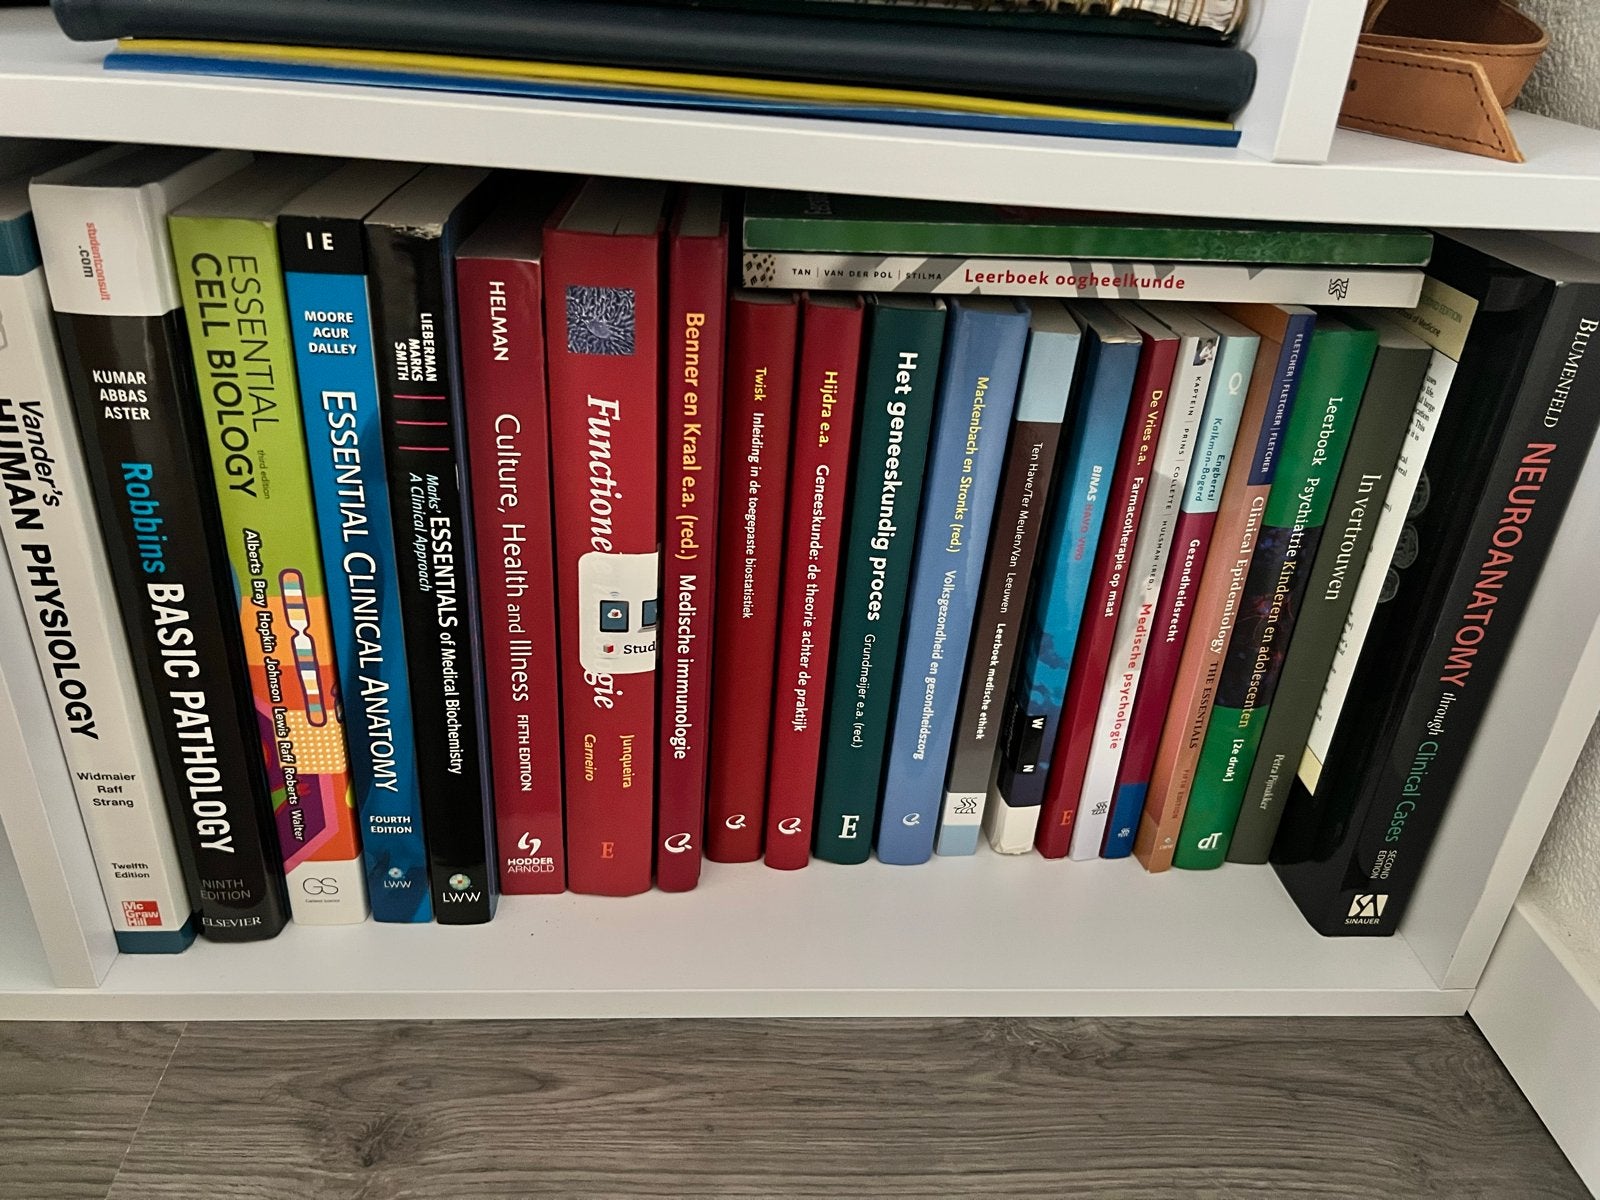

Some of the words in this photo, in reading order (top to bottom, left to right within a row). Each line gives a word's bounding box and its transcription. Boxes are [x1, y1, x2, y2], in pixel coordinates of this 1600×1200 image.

[78, 245, 94, 278] .com
[86, 222, 111, 300] studentconsult
[792, 268, 811, 276] TAN
[824, 269, 844, 278] VAN
[849, 270, 868, 279] DER
[873, 271, 893, 279] POL
[906, 272, 943, 280] STILMA
[965, 269, 1049, 285] Leerboek
[1056, 274, 1185, 289] oogheelkunde
[191, 253, 231, 337] CELL
[304, 311, 354, 323] MOORE
[313, 327, 349, 339] AGUR
[489, 281, 509, 361] HELMAN
[228, 255, 279, 432] ESSENTIAL
[308, 342, 357, 355] DALLEY
[395, 342, 409, 381] SMITH
[408, 338, 423, 382] MARKS
[420, 312, 437, 382] LIEBERMAN
[684, 312, 705, 387] Benner
[1285, 333, 1304, 377] FLETCHER
[93, 370, 147, 385] KUMAR
[754, 367, 767, 401] Twisk
[895, 351, 919, 394] Het
[1543, 317, 1600, 428] BLUMENFELD
[100, 388, 148, 403] ABBAS
[104, 406, 151, 421] ASTER
[683, 392, 698, 416] en
[819, 371, 838, 418] Hijdra
[965, 376, 990, 455] Mackenbach
[1150, 390, 1163, 408] De
[1187, 376, 1202, 416] KAPTEIN
[1273, 384, 1290, 426] FLETCHER
[208, 351, 257, 498] BIOLOGY
[748, 412, 765, 463] Inleiding
[818, 422, 831, 448] e.a.
[1142, 410, 1159, 441] Vries
[1178, 428, 1190, 455] PRINS
[1311, 397, 1343, 466] Leerboek
[19, 401, 63, 507] Vander's
[322, 390, 368, 542] ESSENTIAL
[494, 413, 522, 513] Culture,
[683, 423, 702, 471] Kraal
[963, 458, 973, 473] en
[1030, 442, 1044, 460] Ten
[1137, 444, 1149, 466] e.a.
[1195, 417, 1223, 502] Kalkman-Bogerd
[1261, 433, 1278, 473] FLETCHER
[681, 476, 696, 508] e.a.
[749, 480, 761, 494] de
[750, 466, 760, 477] in
[870, 401, 907, 551] geneeskundig
[1022, 463, 1039, 508] Have/Ter
[1087, 465, 1102, 502] BINAS
[1165, 466, 1181, 510] COLLETTE
[1358, 473, 1382, 493] In
[121, 462, 166, 574] Robbins
[410, 486, 425, 533] Clinical
[808, 464, 830, 561] Geneeskunde:
[955, 476, 973, 521] Stronks
[1286, 477, 1320, 557] Psychiatrie
[675, 514, 699, 560] (red.)
[744, 496, 759, 554] toegepaste
[946, 523, 965, 554] (red.)
[1009, 510, 1029, 567] Meulen/Van
[1114, 477, 1144, 571] Farmacotherapie
[1153, 520, 1168, 561] HULSMAN
[1238, 496, 1264, 554] Clinical
[245, 529, 261, 573] Alberts
[414, 535, 432, 592] Approach
[502, 524, 529, 597] Health
[1325, 496, 1370, 601] vertrouwen
[1439, 442, 1557, 688] NEUROANATOMY
[253, 581, 266, 606] Bray
[430, 517, 458, 628] ESSENTIALS
[742, 557, 756, 618] biostatistiek
[807, 564, 822, 580] de
[867, 557, 887, 621] proces
[1001, 572, 1016, 613] Leeuwen
[1109, 573, 1121, 587] op
[1166, 539, 1200, 643] Gezondheidsrecht
[1268, 559, 1297, 625] Kinderen
[343, 552, 384, 668] CLINICAL
[507, 603, 526, 633] and
[677, 574, 697, 654] Medische
[803, 582, 820, 627] theorie
[930, 570, 957, 660] Volksgezondheid
[1105, 591, 1117, 617] maat
[1210, 558, 1248, 654] Epidemiology
[21, 544, 99, 740] PHYSIOLOGY
[147, 583, 200, 679] BASIC
[259, 612, 273, 652] Hopkin
[799, 630, 815, 668] achter
[989, 623, 1006, 666] Leerboek
[1128, 604, 1153, 669] Medische
[1263, 627, 1275, 643] en
[265, 658, 281, 702] Johnson
[441, 648, 460, 697] Medical
[509, 640, 532, 702] Illness
[797, 671, 811, 686] de
[856, 634, 876, 699] Grundmeijer
[929, 662, 939, 675] en
[1206, 660, 1219, 685] THE
[1238, 645, 1271, 728] adolescenten
[670, 658, 696, 759] immunologie
[791, 688, 811, 732] praktijk
[981, 668, 998, 711] medische
[1109, 673, 1133, 749] psychologie
[273, 708, 287, 737] Lewis
[359, 675, 398, 792] ANATOMY
[517, 714, 530, 744] FIFTH
[850, 722, 866, 748] (red.)
[913, 677, 937, 760] gezondheidszorg
[976, 712, 988, 740] ethiek
[1190, 686, 1212, 748] ESSENTIALS
[1428, 692, 1456, 736] through
[280, 741, 294, 765] Raff
[446, 699, 464, 774] Biochemistry
[584, 734, 598, 781] Carneiro
[77, 772, 136, 782] Widmaier
[170, 690, 235, 853] PATHOLOGY
[518, 747, 532, 791] EDITION
[619, 734, 635, 788] Junqueira
[1270, 754, 1285, 773] Petra
[1402, 740, 1439, 797] Clinical
[93, 798, 135, 808] Strang
[97, 785, 124, 795] Raff
[285, 768, 298, 805] Roberts
[290, 809, 304, 840] Walter
[370, 815, 411, 824] FOURTH
[370, 825, 412, 834] EDITION
[838, 815, 860, 839] E
[1385, 800, 1416, 843] Cases
[111, 862, 149, 870] Twelfth
[114, 871, 150, 879] Edition
[507, 857, 554, 866] HODDER
[507, 864, 555, 873] ARNOLD
[1369, 849, 1387, 879] EDITION
[1379, 849, 1398, 880] SECOND
[200, 889, 251, 900] EDITION
[202, 879, 244, 889] NINTH
[302, 877, 338, 895] GS
[384, 880, 411, 888] LWW
[442, 891, 481, 903] LWW
[123, 902, 144, 910] Mc
[125, 910, 159, 918] Graw
[128, 918, 147, 926] Hill
[202, 916, 262, 927] ELSEVIER
[1344, 917, 1380, 925] SINAUER
